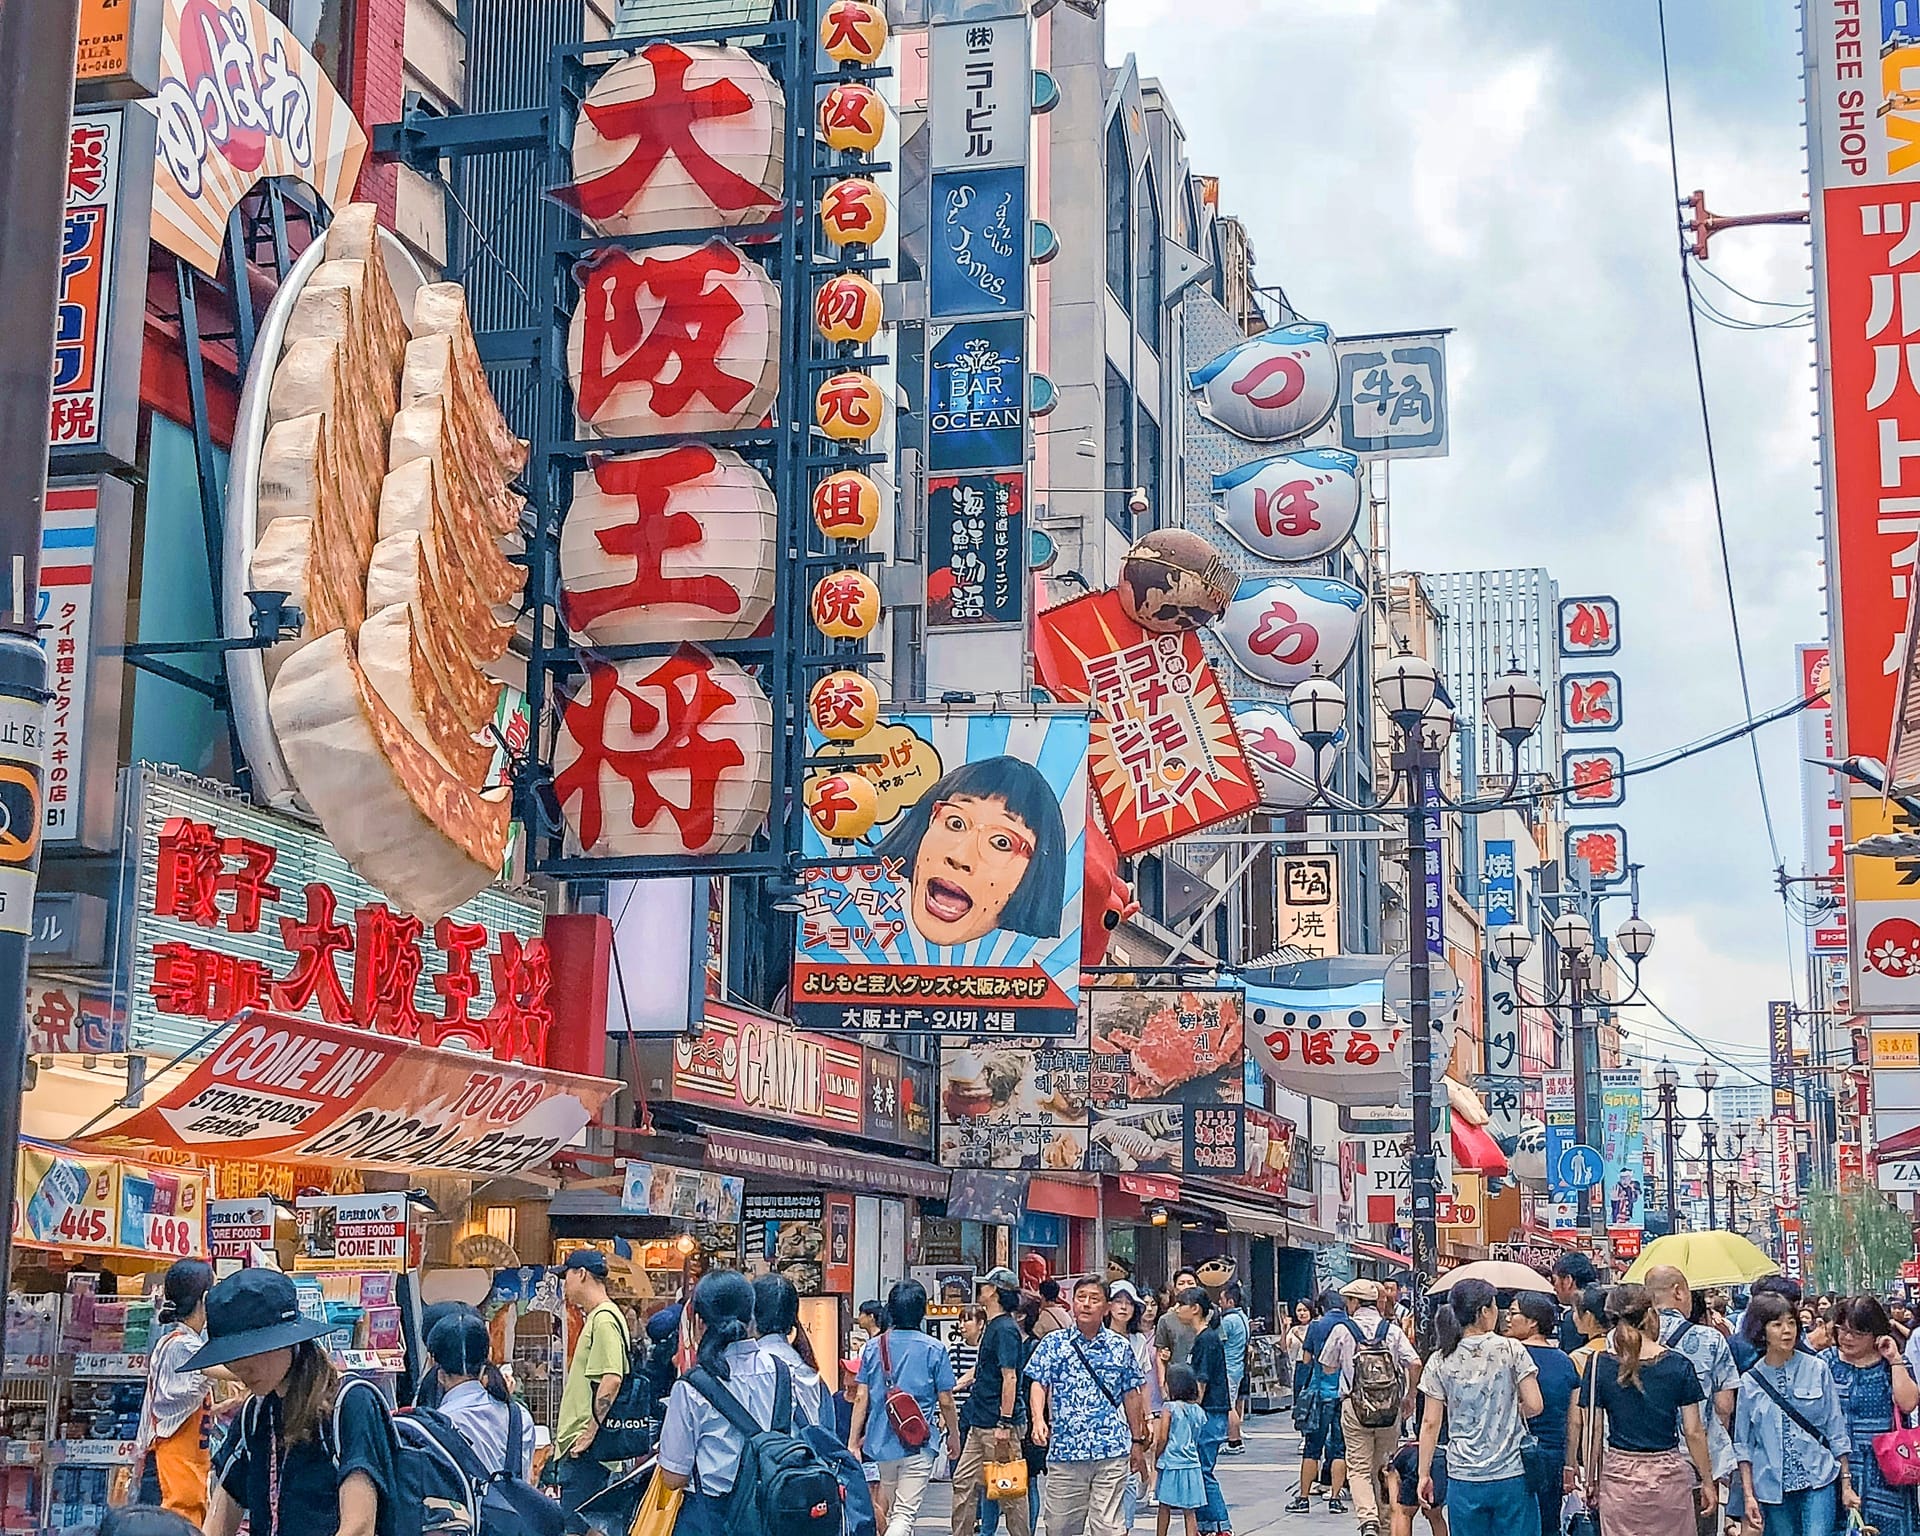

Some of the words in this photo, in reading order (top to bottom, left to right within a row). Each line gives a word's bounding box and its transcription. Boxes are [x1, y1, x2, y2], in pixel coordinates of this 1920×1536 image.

[1833, 0, 1863, 81] FREE
[1838, 90, 1867, 176] SHOP
[946, 185, 976, 233] St.
[951, 226, 1007, 305] James
[930, 325, 945, 337] 3F
[951, 377, 1003, 398] BAR
[1355, 369, 1432, 425] 牛角
[932, 409, 1021, 431] OCEAN
[547, 43, 784, 851] 大阪王将
[47, 602, 76, 803] タイ料理とタイスキの店
[47, 808, 66, 827] B1
[155, 817, 281, 933] 餃子
[1291, 868, 1326, 896] 牛角
[1486, 853, 1514, 915] 焼肉
[804, 888, 905, 915] エンタメ
[802, 920, 905, 950] ショップ
[272, 882, 552, 1068] 大阪王将
[984, 1010, 1016, 1031] 선물
[1774, 1004, 1788, 1053] カラオケ
[212, 1026, 340, 1091] COME
[309, 1045, 386, 1099] IN!
[1264, 1029, 1404, 1066] づぼら
[738, 1025, 825, 1118] GAME
[188, 1088, 262, 1116] STORE
[244, 1099, 316, 1125] FOODS
[451, 1073, 495, 1117] TO
[491, 1079, 545, 1122] GO
[302, 1111, 458, 1168] GYOZA
[457, 1131, 560, 1173] BEER
[1372, 1139, 1448, 1159] PAA
[60, 1205, 107, 1242] 445
[150, 1216, 192, 1256] 498
[213, 1228, 231, 1239] ORE
[232, 1226, 262, 1239] FOODS
[296, 1211, 312, 1226] 3F
[339, 1225, 366, 1238] STORE
[367, 1224, 396, 1237] FOODS
[208, 1242, 240, 1257] OME
[337, 1240, 376, 1257] COME
[378, 1238, 397, 1256] IN!
[25, 1354, 49, 1369] 448
